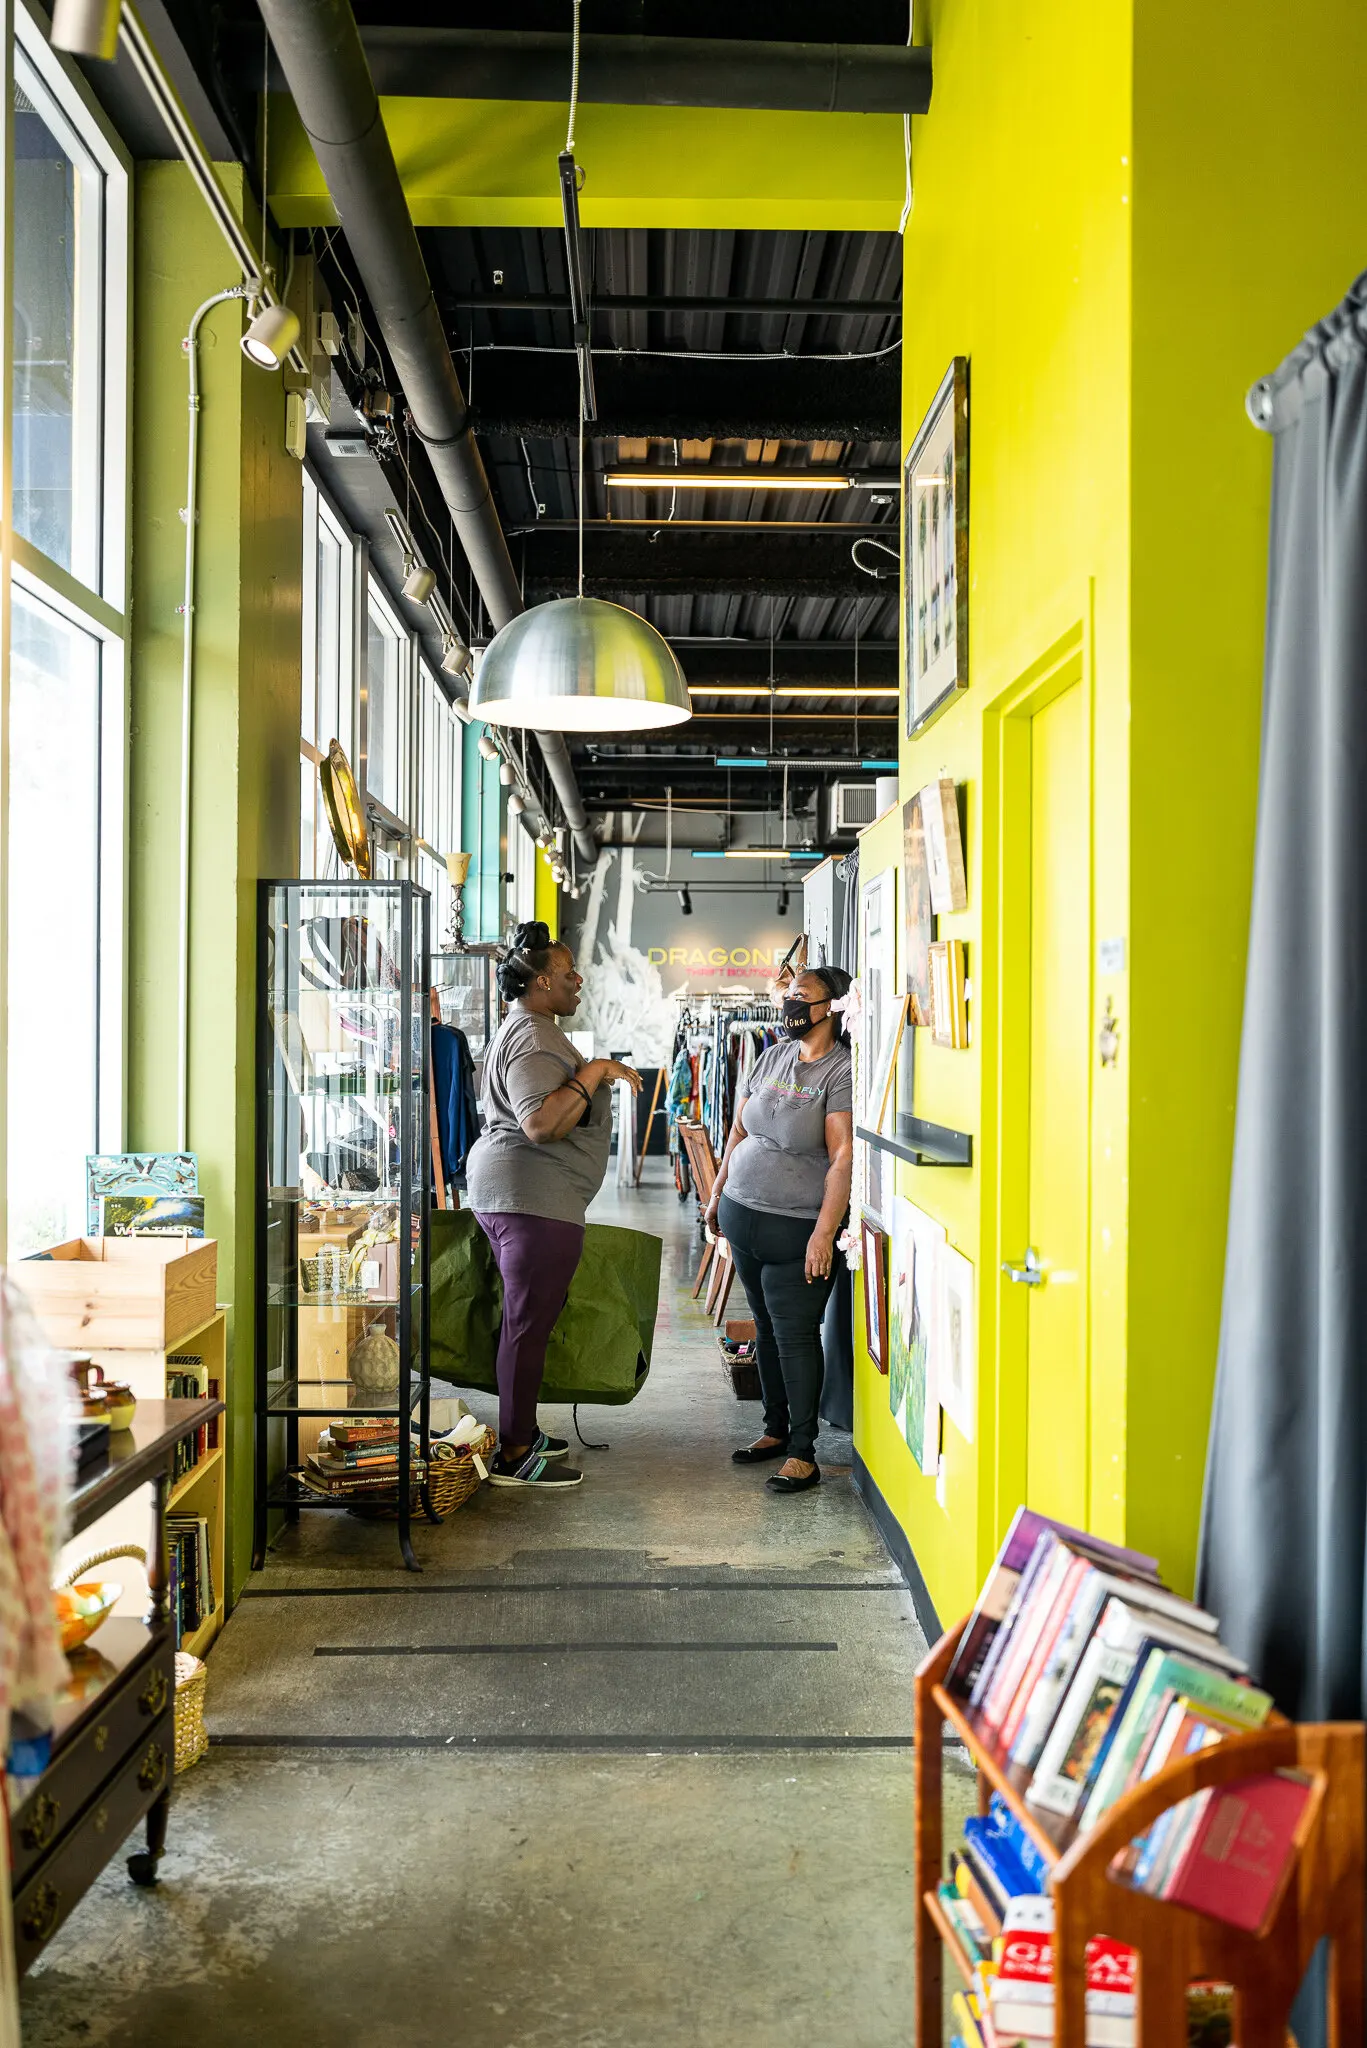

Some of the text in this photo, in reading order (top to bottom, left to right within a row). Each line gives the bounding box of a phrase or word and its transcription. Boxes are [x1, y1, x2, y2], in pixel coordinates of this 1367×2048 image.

[648, 947, 798, 967] DRAGONFL
[727, 968, 779, 978] BOUTIQU
[784, 1015, 806, 1029] lina
